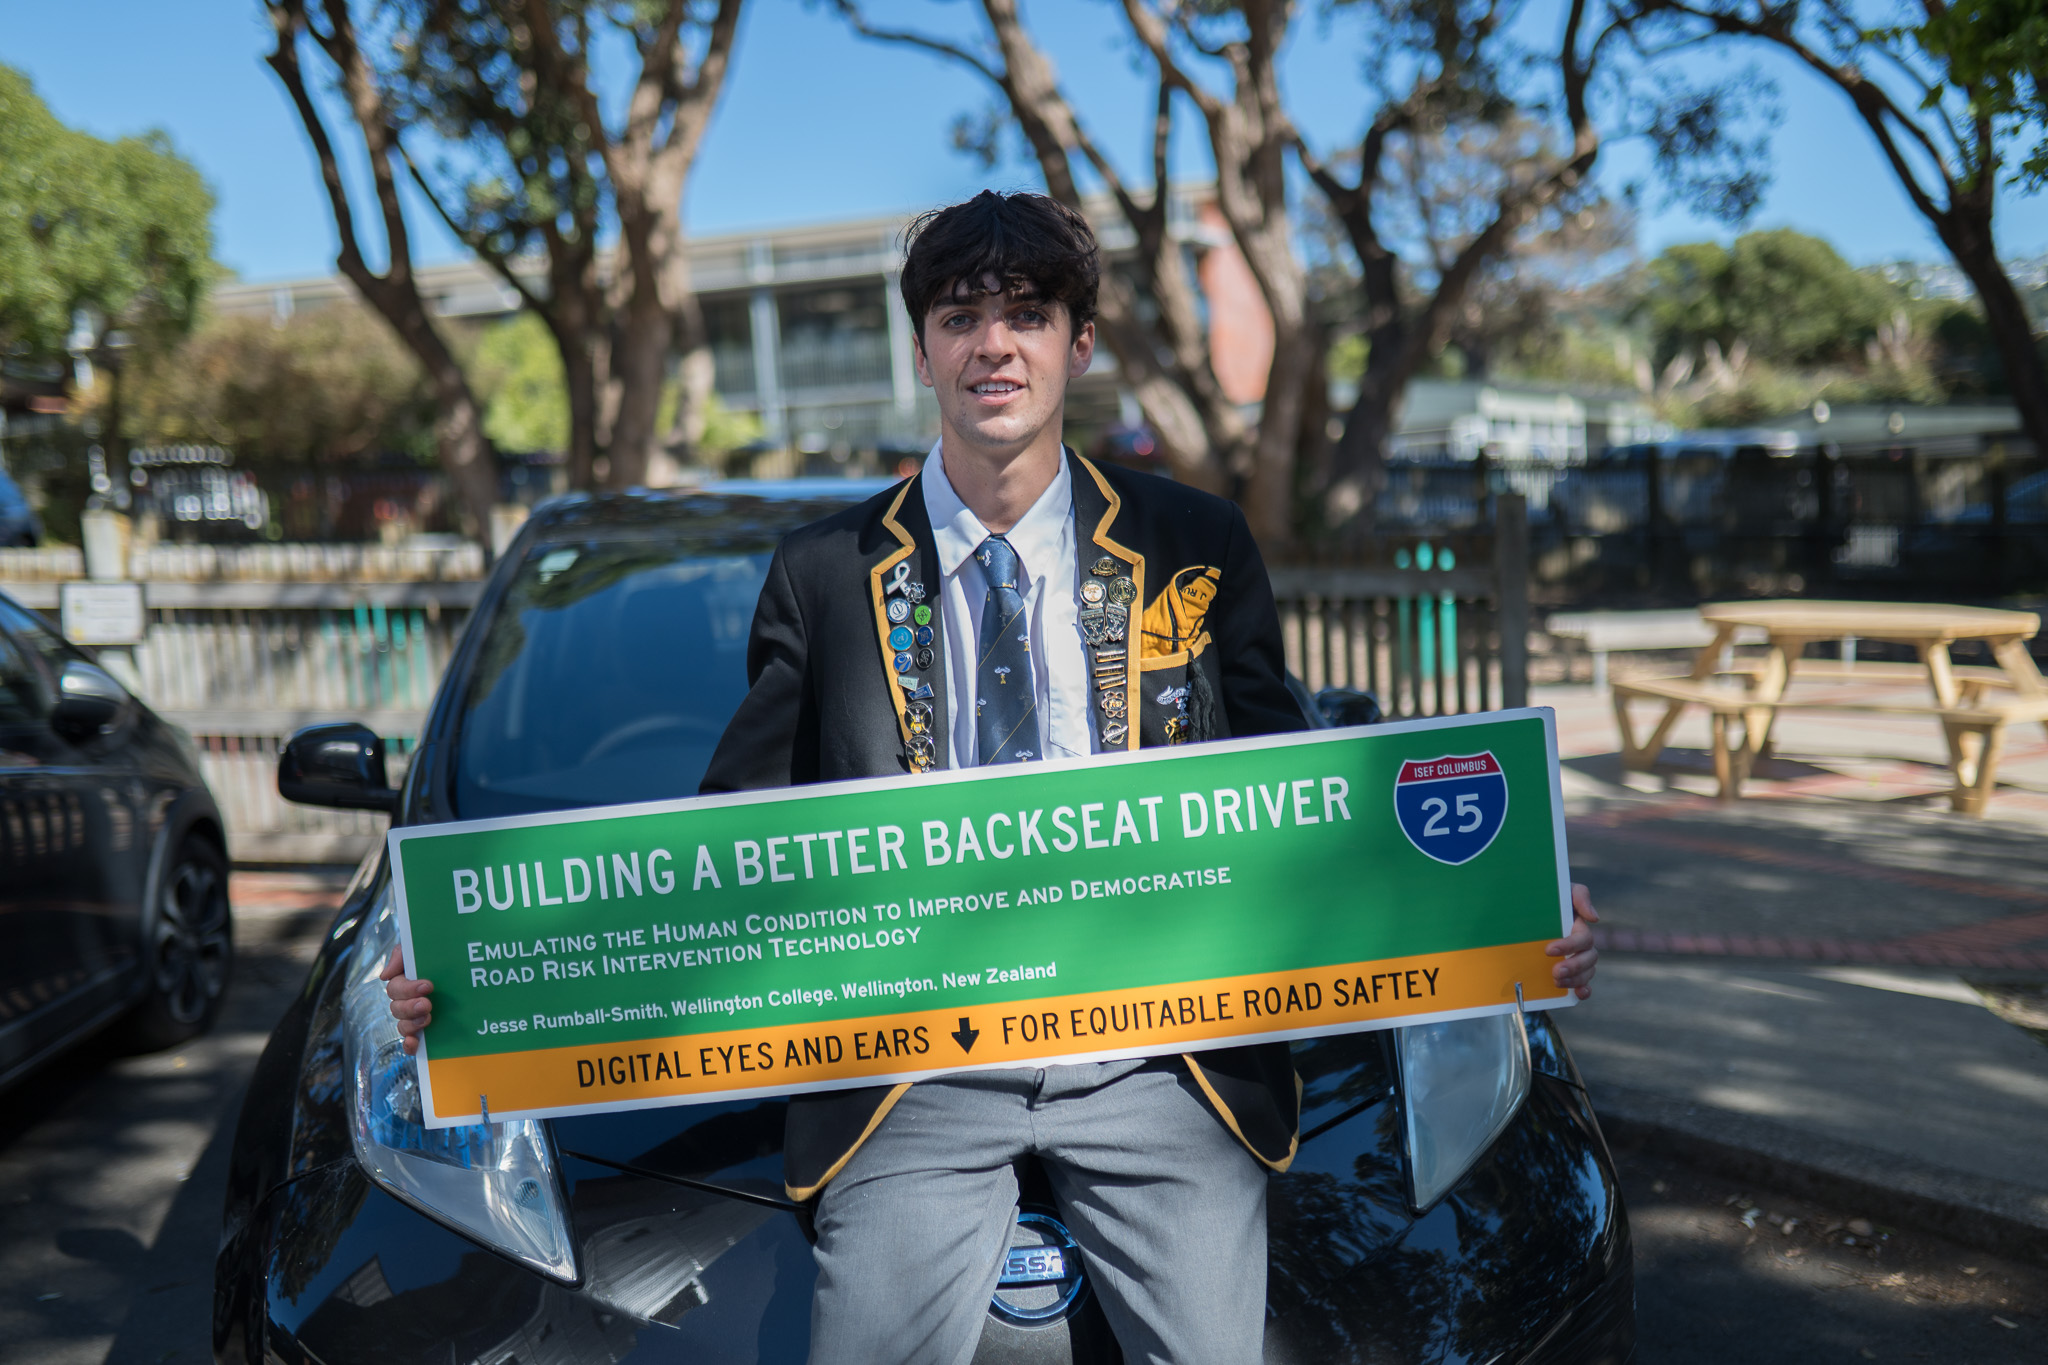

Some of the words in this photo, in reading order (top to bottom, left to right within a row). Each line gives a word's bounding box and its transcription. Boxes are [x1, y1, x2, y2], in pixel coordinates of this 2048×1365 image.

[1414, 766, 1435, 778] ISEF
[1437, 760, 1488, 775] COLUMBUS
[452, 848, 676, 914] BUILDING
[692, 844, 722, 891] A
[734, 824, 909, 886] BETTER
[921, 795, 1164, 867] BACKSEAT
[1179, 776, 1352, 839] DRIVER
[1421, 793, 1483, 837] 25
[467, 934, 597, 963] EMULATING
[602, 929, 647, 949] THE
[652, 919, 738, 945] HUMAN
[745, 906, 867, 935] CONDITION
[872, 903, 902, 922] TO
[908, 891, 1010, 918] IMPROVE
[1016, 885, 1064, 907] AND
[1070, 866, 1232, 901] DEMOCRATISE
[471, 966, 535, 988] ROAD
[542, 960, 596, 981] RISK
[602, 943, 763, 975] INTERVENTION
[767, 926, 921, 958] TECHNOLOGY
[477, 1019, 529, 1036] Jesse
[532, 1003, 668, 1030] Rumball-Smith,
[671, 994, 763, 1017] Wellington
[767, 987, 838, 1007] College,
[840, 977, 938, 1000] Wellington,
[942, 972, 981, 989] New
[985, 961, 1057, 985] Zealand
[1002, 1012, 1060, 1044] FOR
[1070, 992, 1234, 1037] EQUITABLE
[1243, 982, 1322, 1018] ROAD
[1333, 967, 1440, 1008] SAFTEY
[576, 1050, 692, 1089] DIGITAL
[699, 1042, 774, 1076] EYES
[784, 1035, 843, 1068] AND
[853, 1025, 930, 1061] EARS
